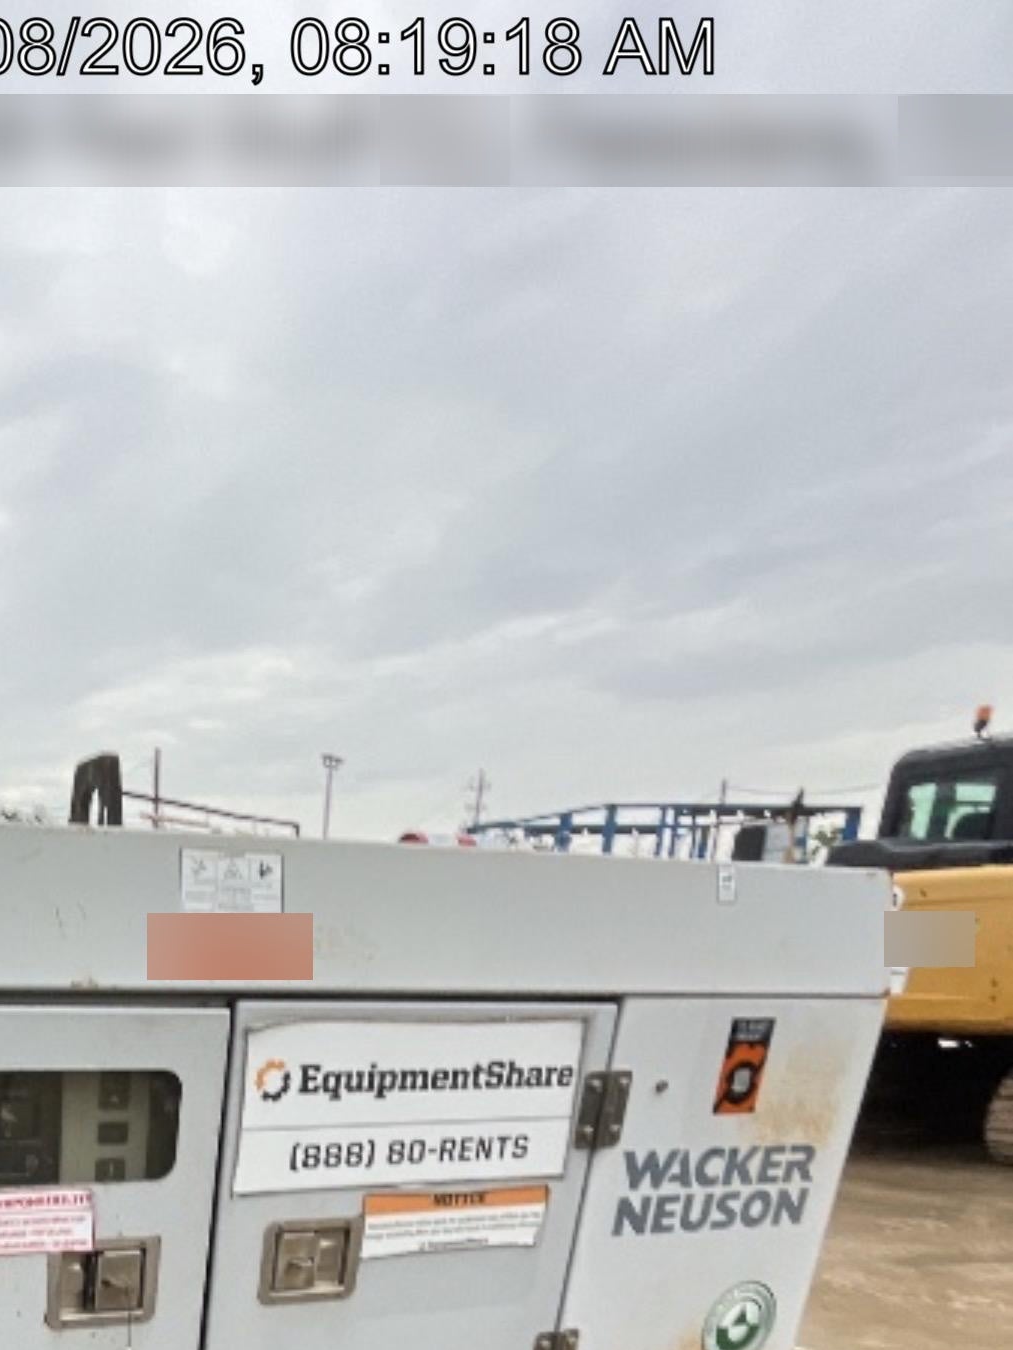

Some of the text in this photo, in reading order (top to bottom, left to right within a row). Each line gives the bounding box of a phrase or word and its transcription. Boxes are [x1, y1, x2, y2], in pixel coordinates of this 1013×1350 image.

[298, 1060, 575, 1101] EquipmentShare
[289, 1134, 531, 1173] (888) 80-RENTS
[622, 1145, 817, 1191] WACKER
[611, 1187, 810, 1237] NEUSON
